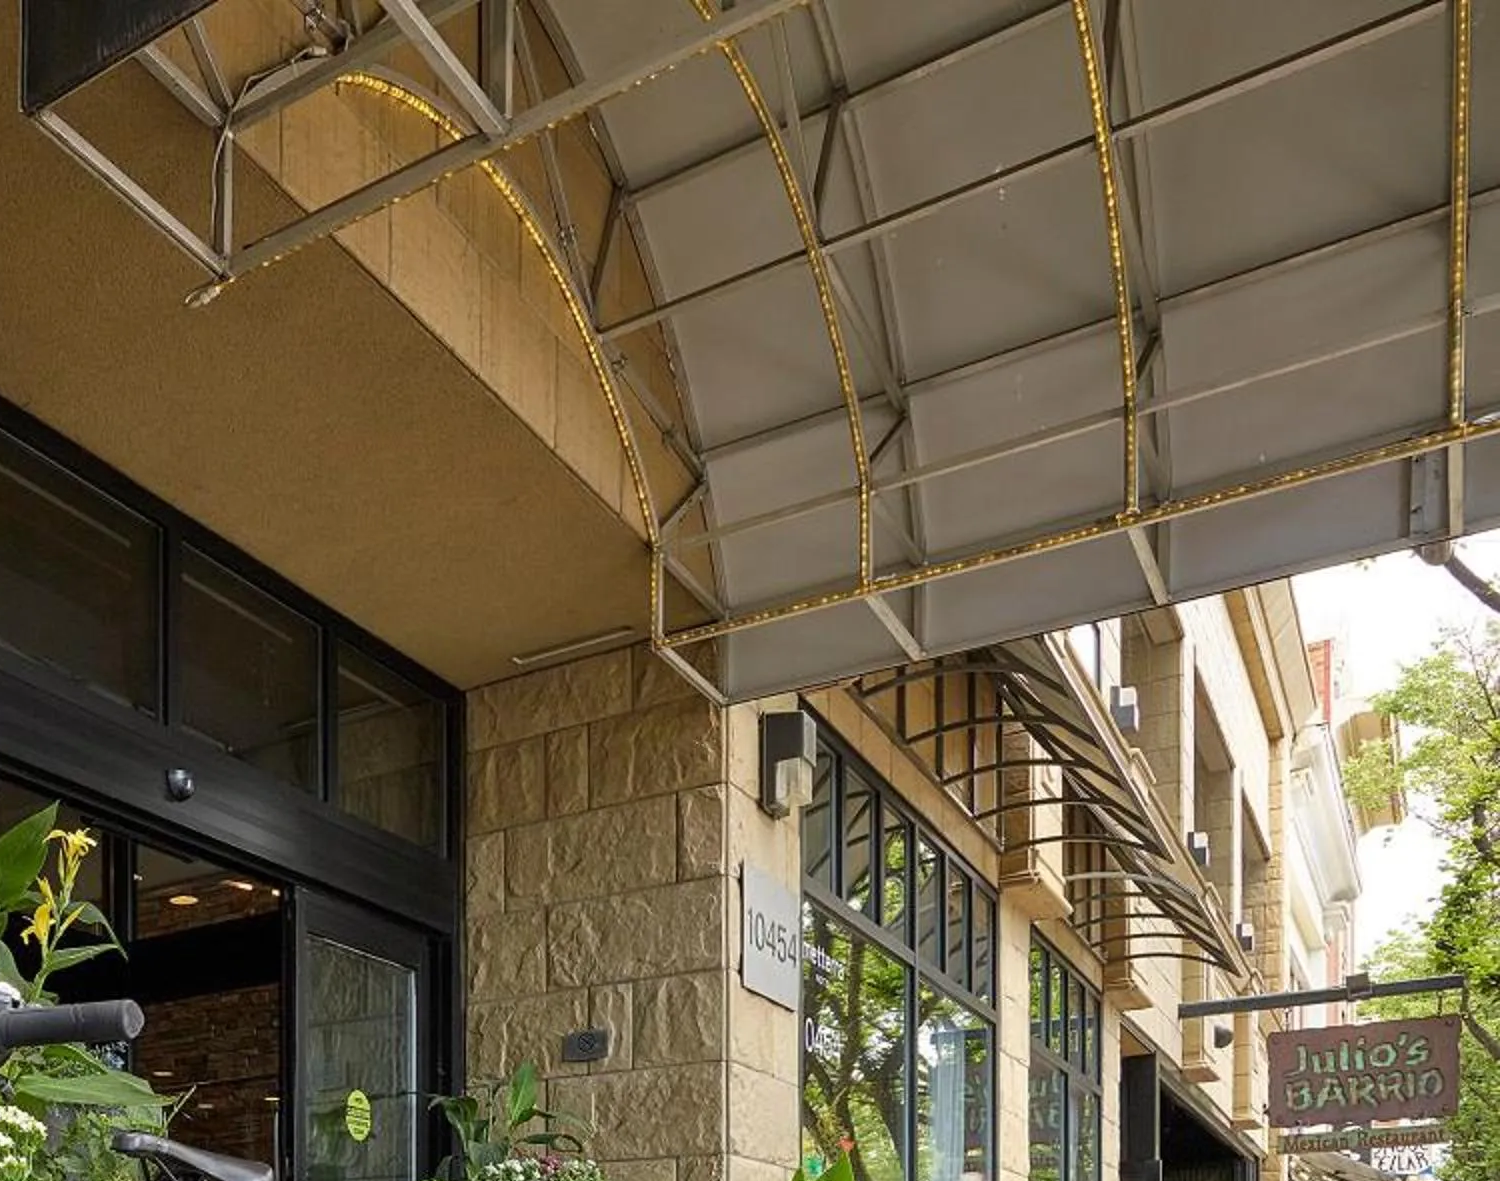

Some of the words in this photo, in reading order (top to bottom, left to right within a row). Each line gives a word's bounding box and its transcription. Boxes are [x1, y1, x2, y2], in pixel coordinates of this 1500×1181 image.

[747, 906, 797, 969] 10454
[1285, 1032, 1430, 1077] Julio's
[1284, 1068, 1446, 1112] BARRIO
[1283, 1133, 1350, 1152] Mexican
[1357, 1128, 1447, 1148] Restaurant
